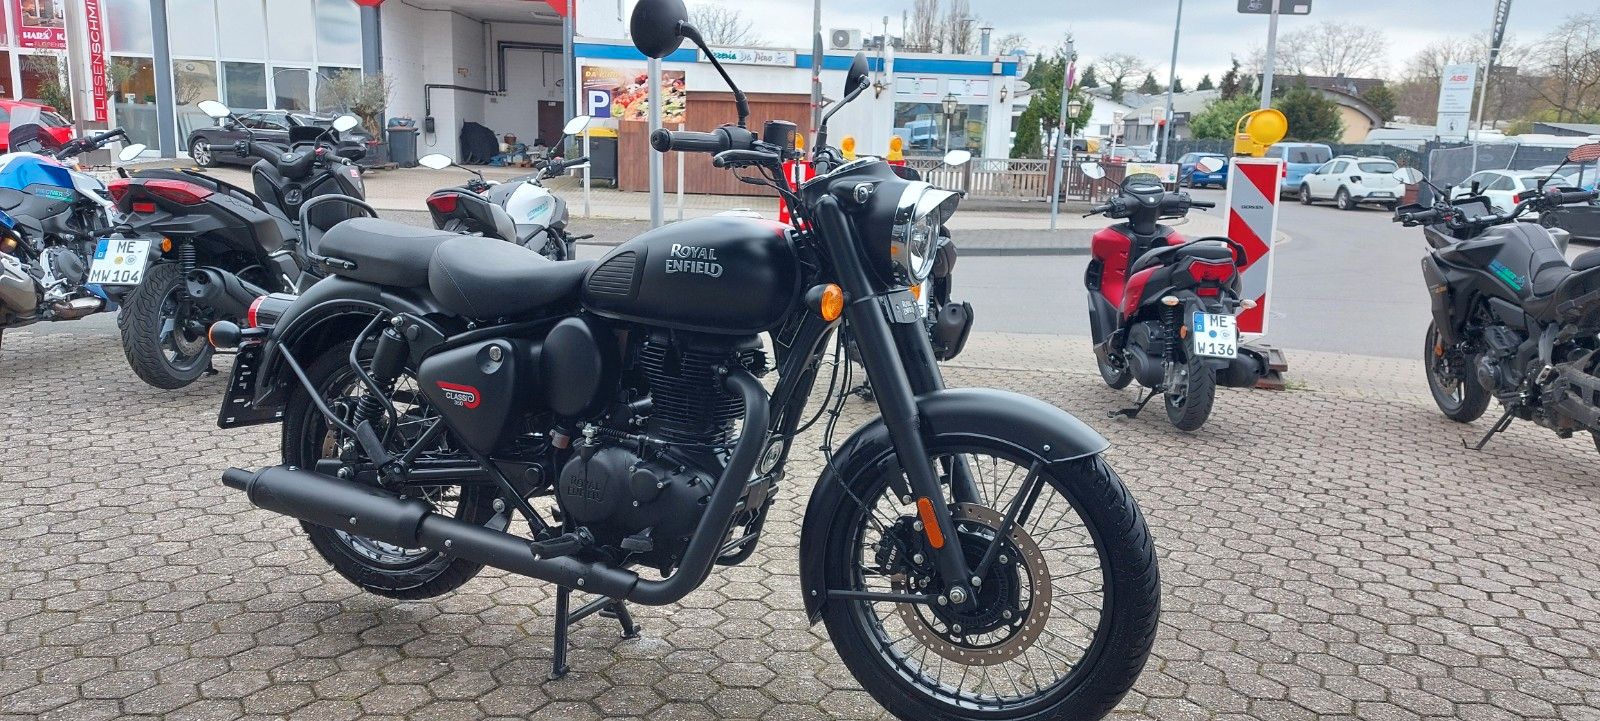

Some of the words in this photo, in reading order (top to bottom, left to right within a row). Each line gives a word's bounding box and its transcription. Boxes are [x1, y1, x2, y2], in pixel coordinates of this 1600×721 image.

[86, 0, 106, 120] FLIESENSCHMI
[588, 90, 610, 116] P
[670, 243, 717, 260] ROYAL
[111, 270, 140, 283] 104
[665, 259, 723, 278] ENFIELD
[1197, 341, 1206, 354] W
[1209, 343, 1235, 356] 136
[445, 391, 475, 403] CLASSIC
